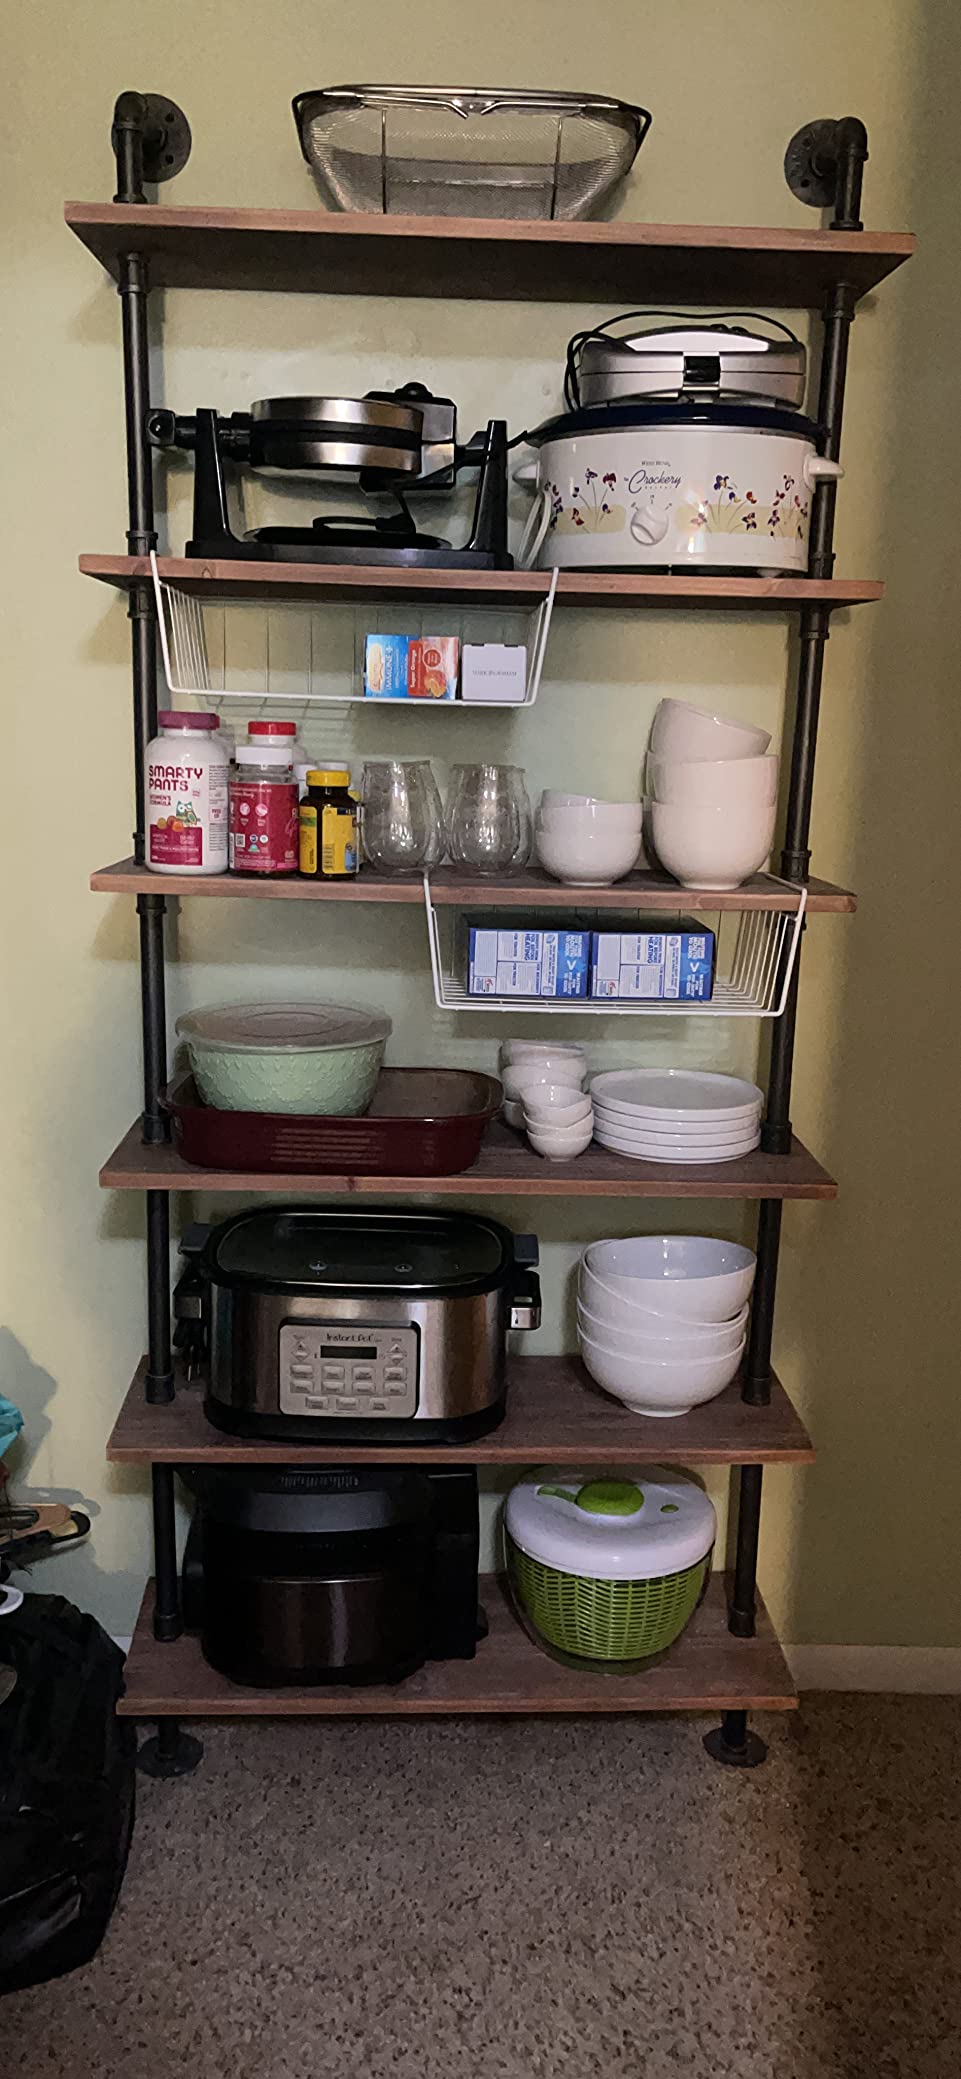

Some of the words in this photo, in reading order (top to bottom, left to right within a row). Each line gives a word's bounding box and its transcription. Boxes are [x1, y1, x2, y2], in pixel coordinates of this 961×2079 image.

[628, 469, 681, 494] Crockery
[148, 765, 203, 780] SMARTY
[148, 778, 189, 792] PANTS
[326, 1333, 355, 1342] Instant
